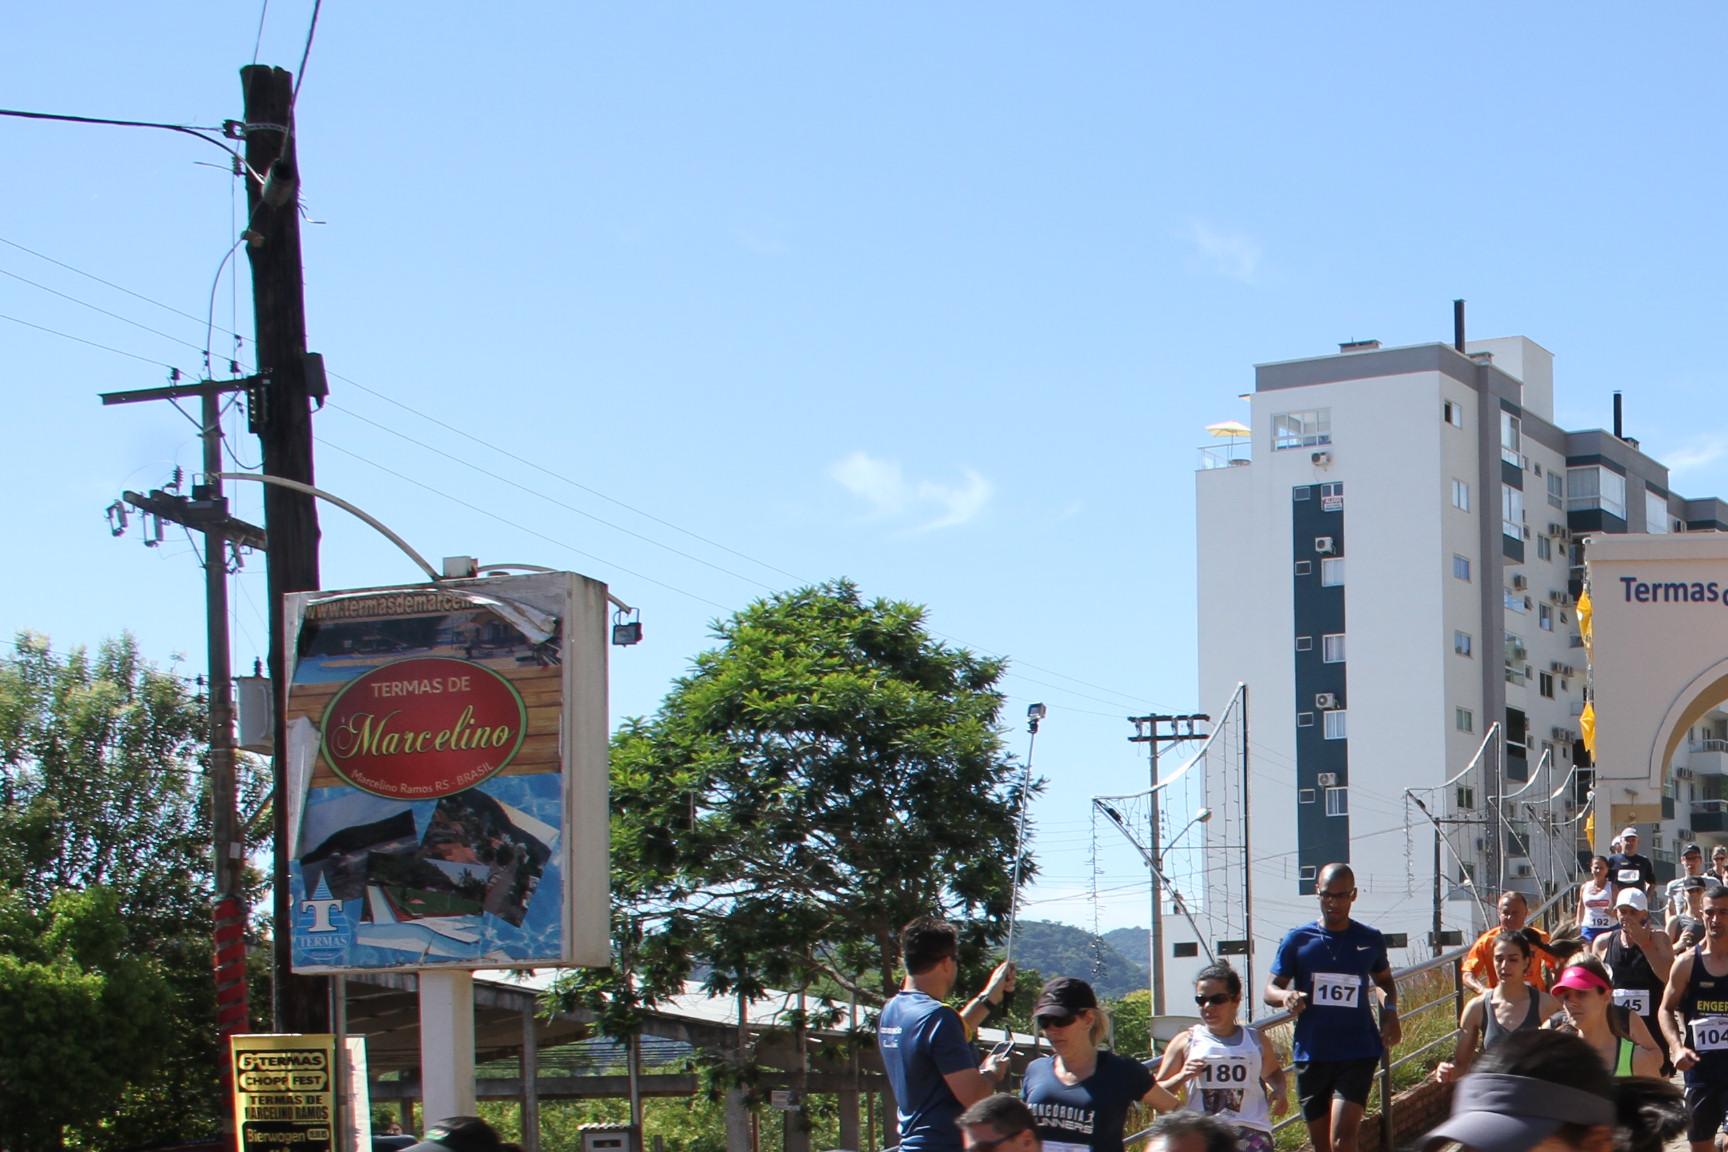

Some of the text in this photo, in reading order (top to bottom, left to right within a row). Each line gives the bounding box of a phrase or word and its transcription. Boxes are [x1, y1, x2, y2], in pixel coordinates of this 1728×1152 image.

[1620, 576, 1719, 603] Termas
[371, 676, 472, 698] TERMAS DE
[331, 704, 514, 759] Marcelino
[351, 768, 398, 793] Marcelino
[400, 783, 433, 794] Ramos
[435, 780, 450, 792] RS
[456, 762, 494, 786] BRASIL
[1592, 918, 1609, 926] 192
[300, 936, 348, 947] TERMAS
[1318, 984, 1357, 1002] 167
[259, 1055, 322, 1067] TERMAS
[293, 1075, 322, 1086] FEST
[1202, 1064, 1247, 1083] 180
[249, 1095, 323, 1105] TERMAS DE
[1035, 1116, 1094, 1135] UNNERS
